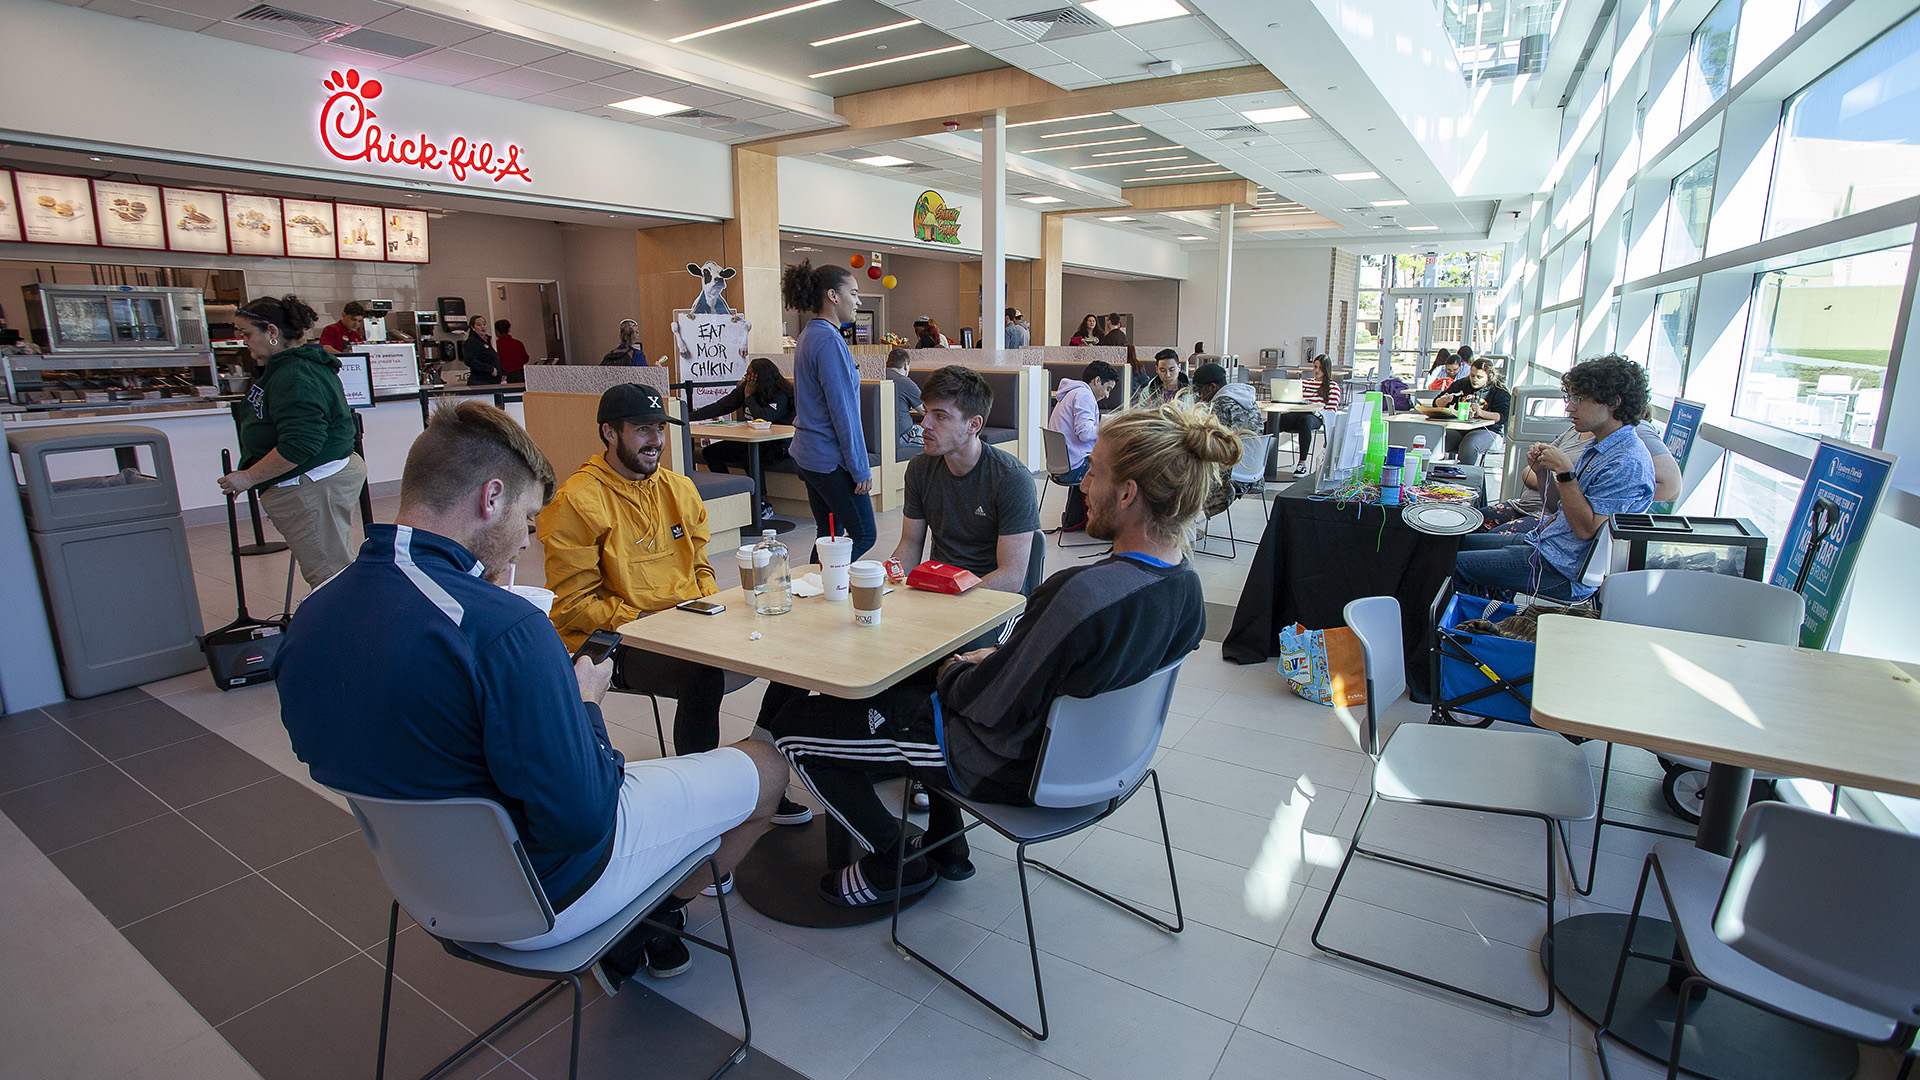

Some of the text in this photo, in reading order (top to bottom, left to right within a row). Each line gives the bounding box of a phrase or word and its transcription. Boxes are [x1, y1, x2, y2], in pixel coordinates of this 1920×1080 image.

[320, 85, 532, 182] Chick-fil-A
[698, 323, 725, 341] EAT
[696, 343, 728, 361] MOR
[691, 361, 733, 376] CHIKIN
[647, 396, 662, 408] X
[1849, 467, 1863, 479] Florida
[868, 708, 876, 735] adidas
